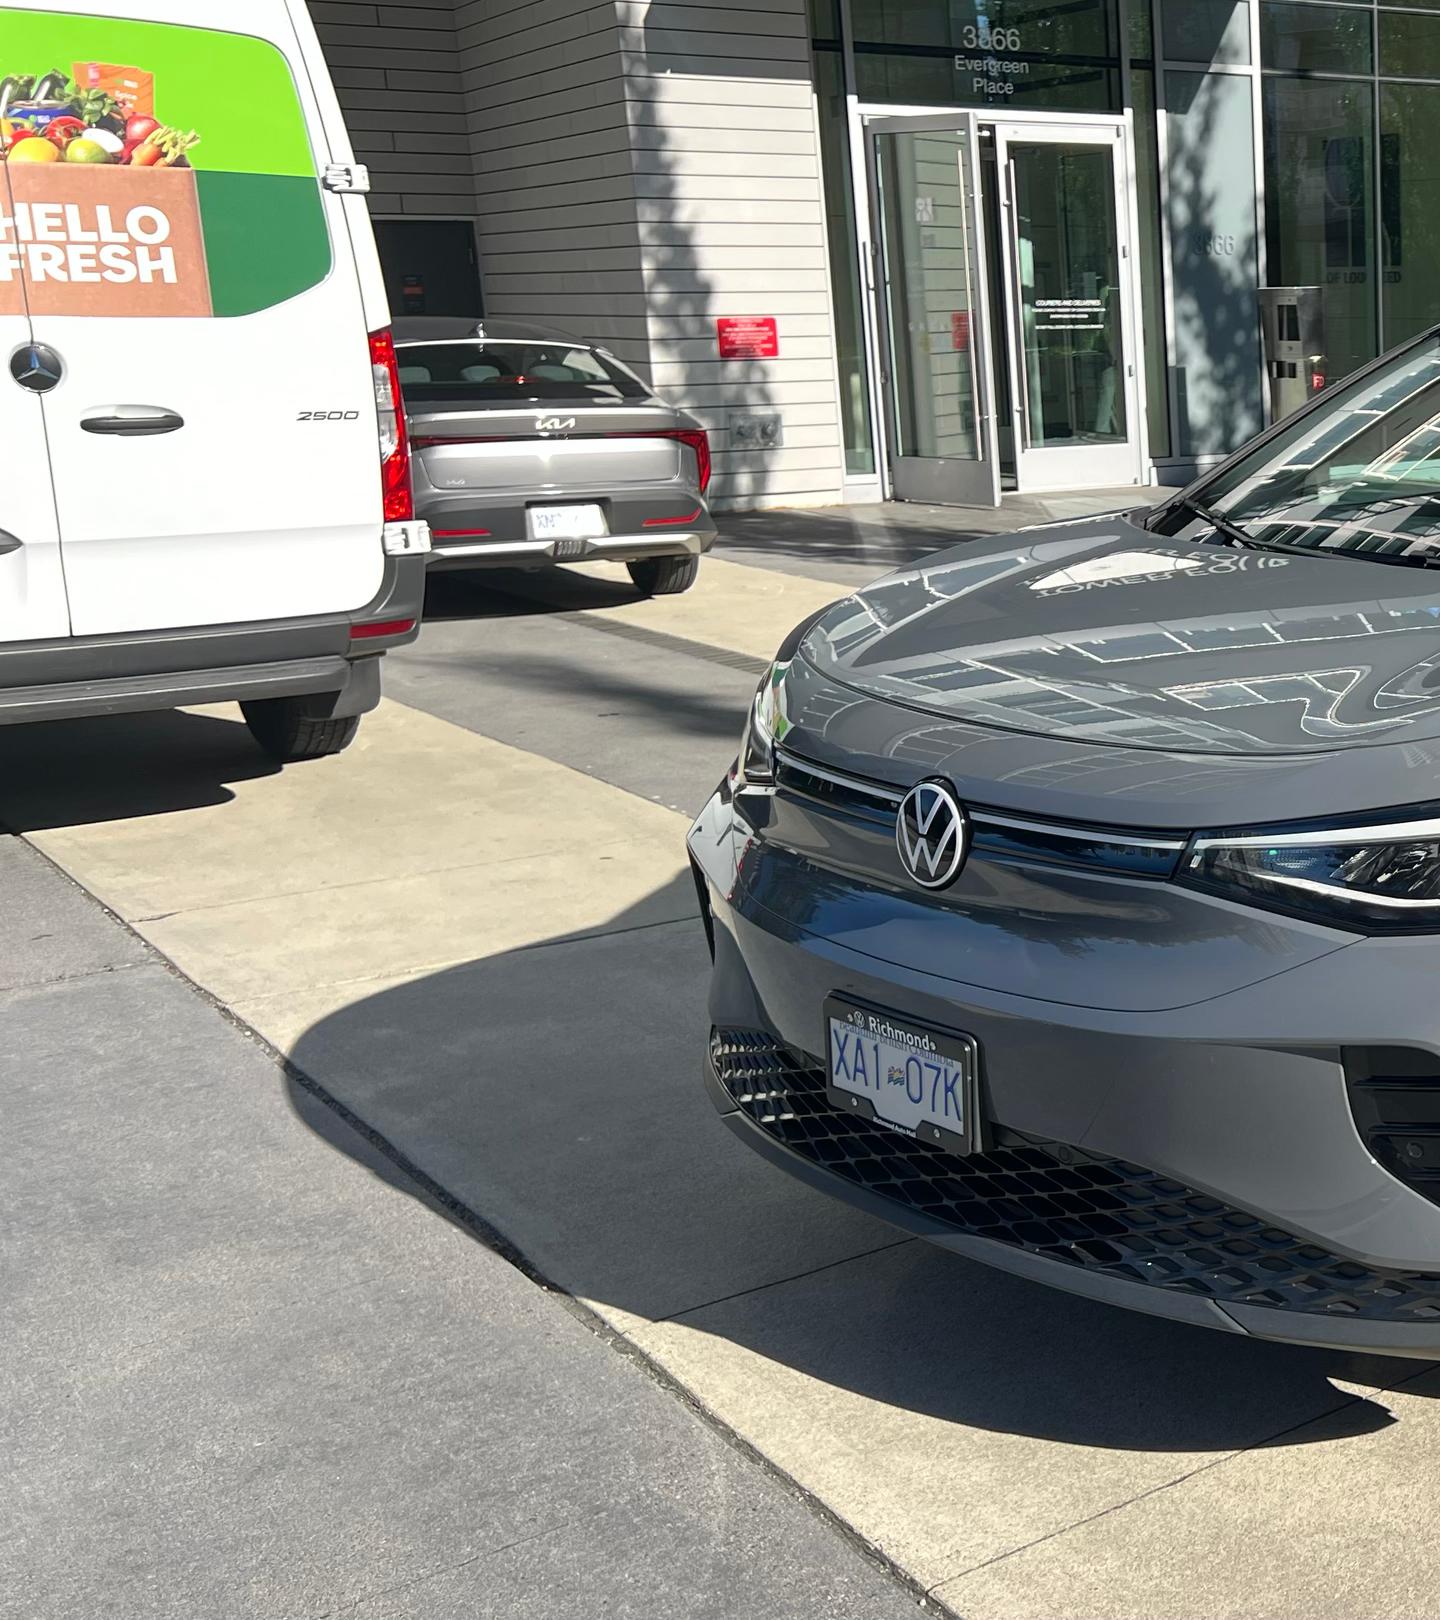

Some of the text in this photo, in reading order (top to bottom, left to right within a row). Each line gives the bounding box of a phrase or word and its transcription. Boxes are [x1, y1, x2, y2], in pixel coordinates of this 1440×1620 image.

[962, 25, 1021, 51] 3866
[954, 54, 1029, 77] Evergreen
[972, 77, 1014, 95] Place
[0, 202, 170, 244] HELLO
[0, 243, 177, 283] FRESH
[296, 411, 360, 422] 2500
[868, 1016, 930, 1050] Richmond
